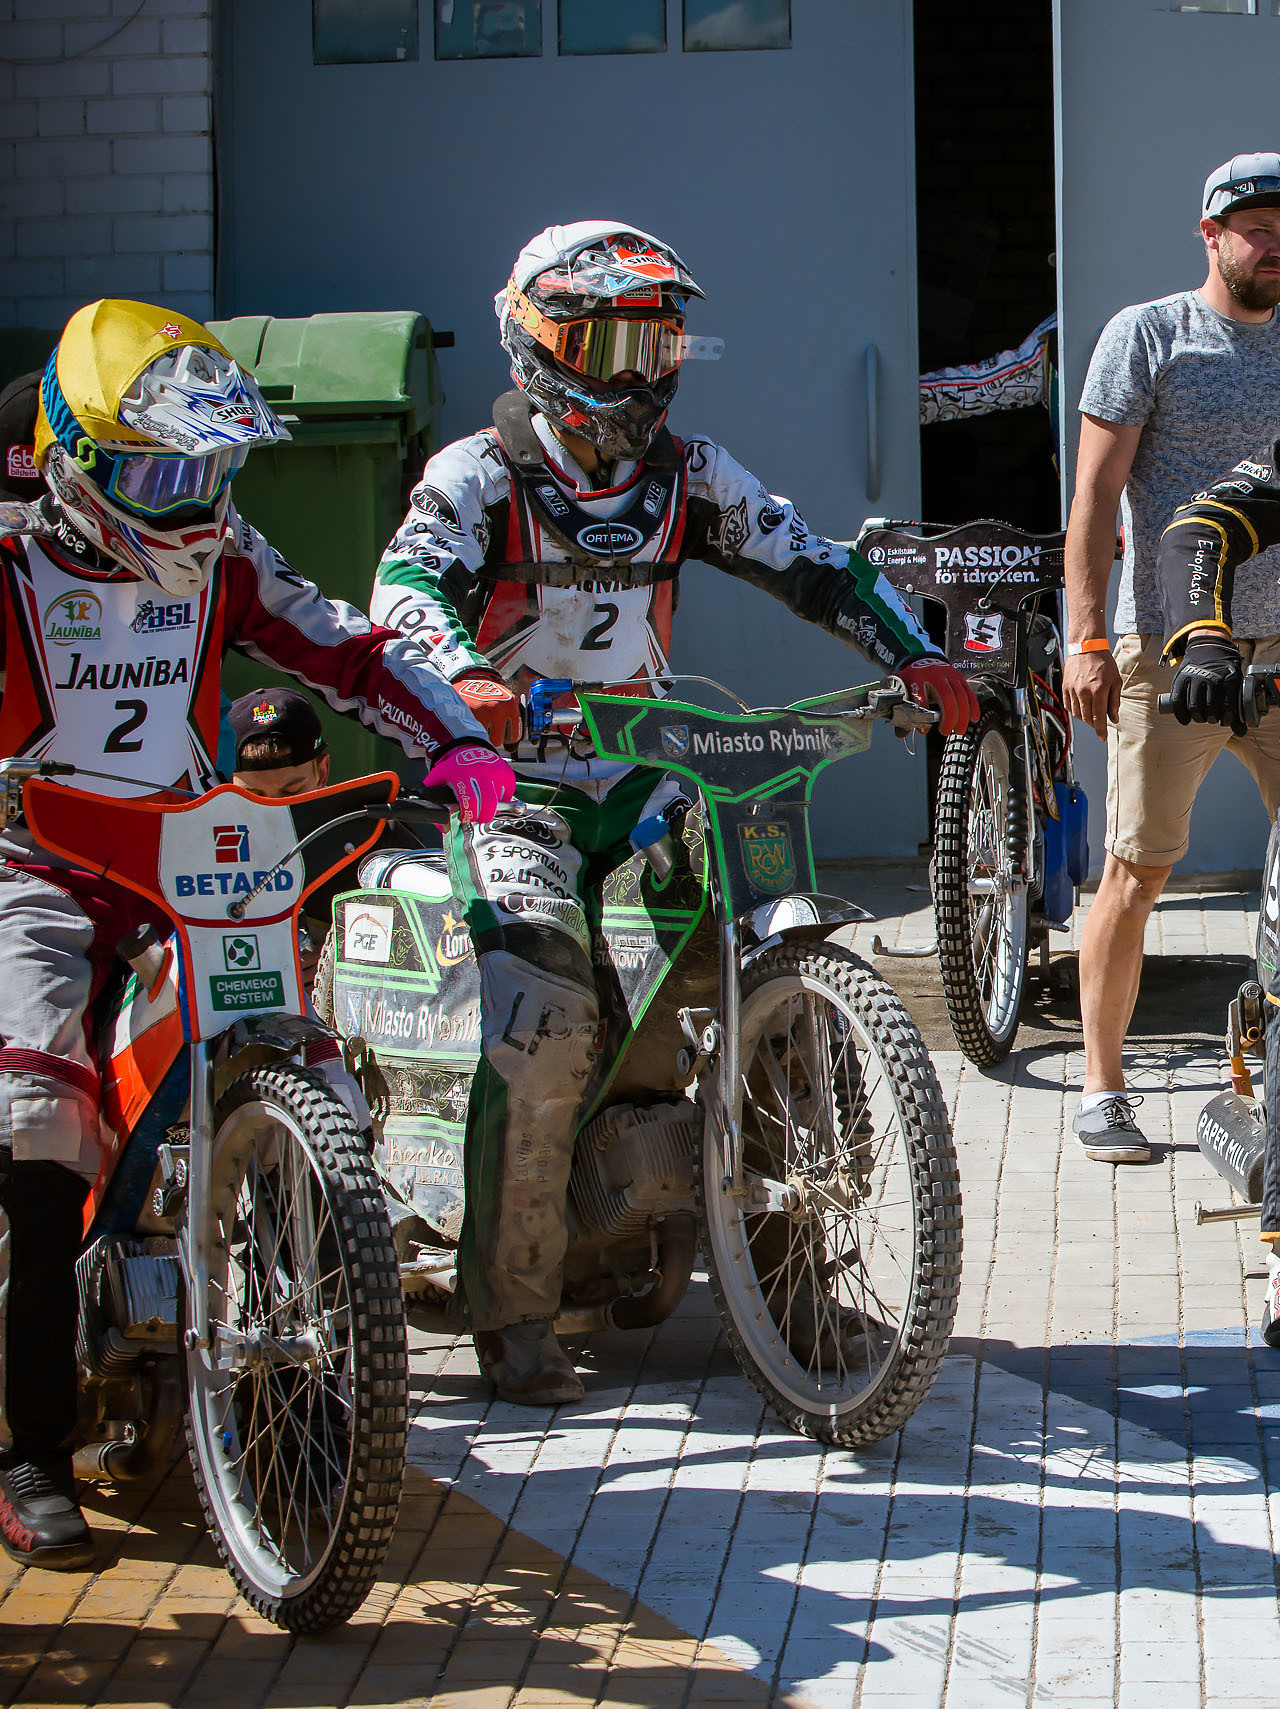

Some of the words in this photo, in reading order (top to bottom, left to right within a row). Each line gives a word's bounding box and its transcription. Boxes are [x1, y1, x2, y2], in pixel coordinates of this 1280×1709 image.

[586, 532, 634, 543] ORTEMA
[935, 545, 1042, 568] PASSION
[935, 569, 960, 585] för
[579, 602, 620, 650] 2
[55, 652, 188, 690] JAUNĪBA
[103, 698, 149, 754] 2
[693, 732, 764, 755] Miasto
[769, 728, 833, 757] Rybnik
[353, 931, 378, 951] PGE
[216, 977, 278, 992] CHEMEKO
[224, 991, 274, 1005] SYSTEM
[1198, 1111, 1230, 1157] PAPER
[1224, 1138, 1250, 1177] MILL
